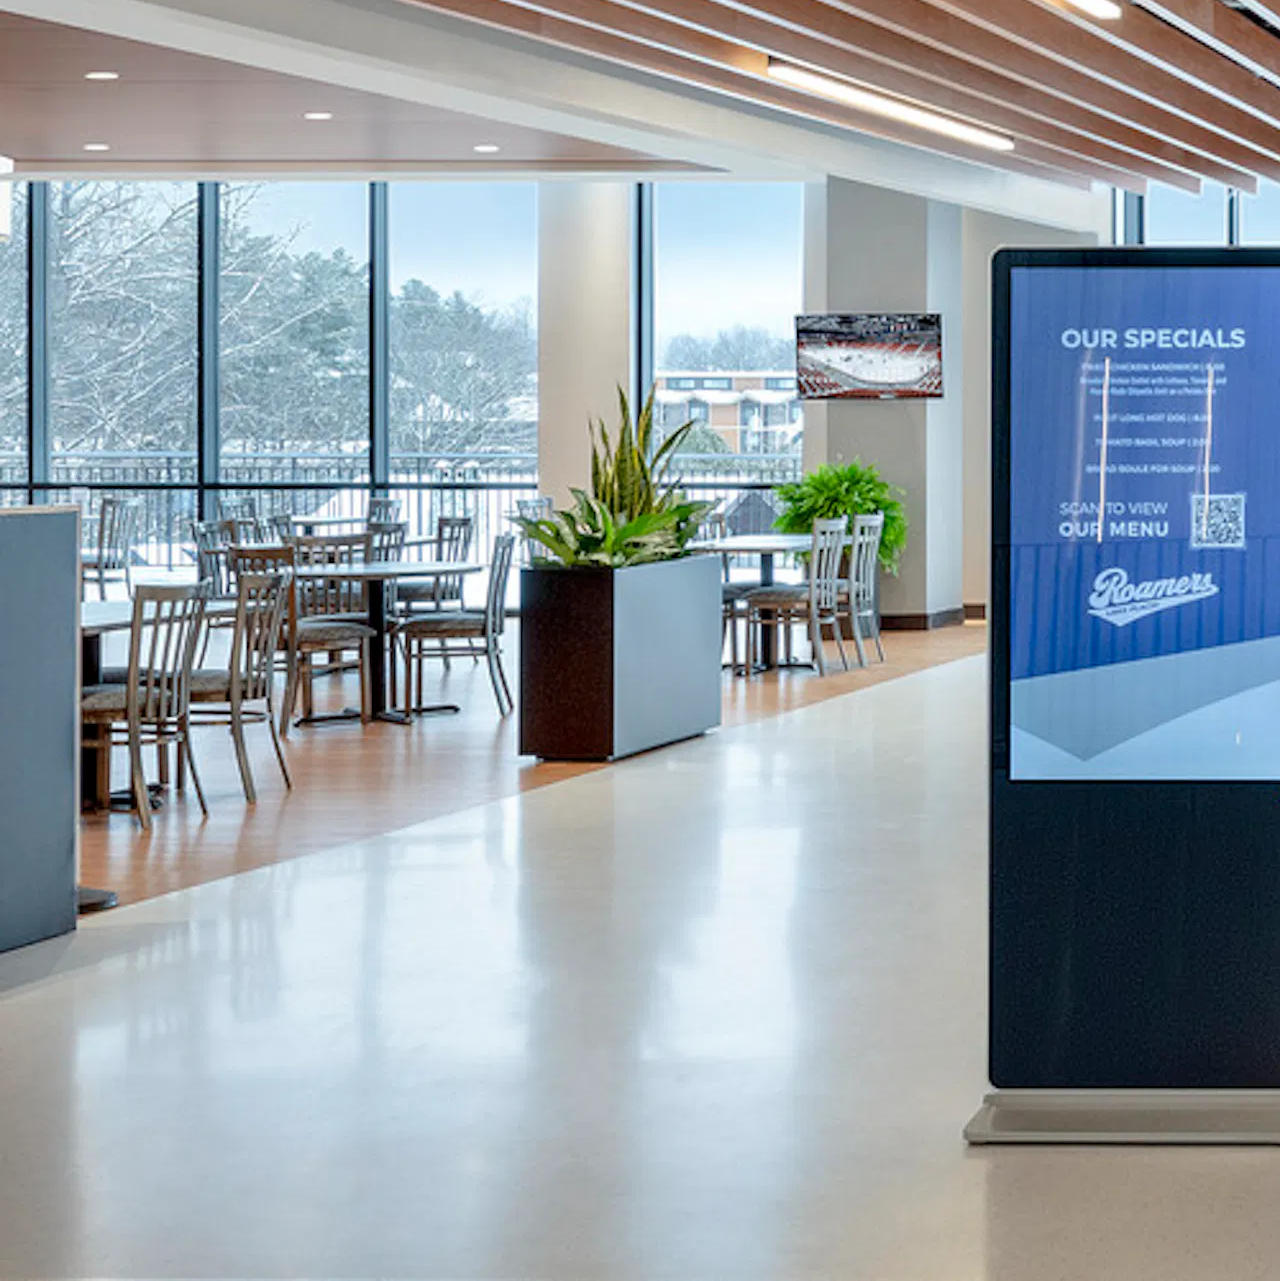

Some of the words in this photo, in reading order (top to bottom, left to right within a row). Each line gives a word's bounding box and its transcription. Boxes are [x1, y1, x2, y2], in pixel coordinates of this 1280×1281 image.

[1061, 328, 1118, 348] OUR
[1124, 328, 1246, 348] SPECIALS
[1059, 502, 1100, 515] SCAN
[1107, 502, 1126, 515] TO
[1128, 502, 1168, 515] VIEW
[1058, 522, 1102, 537] OUR
[1110, 522, 1169, 537] MENU
[1089, 568, 1216, 608] Roamers
